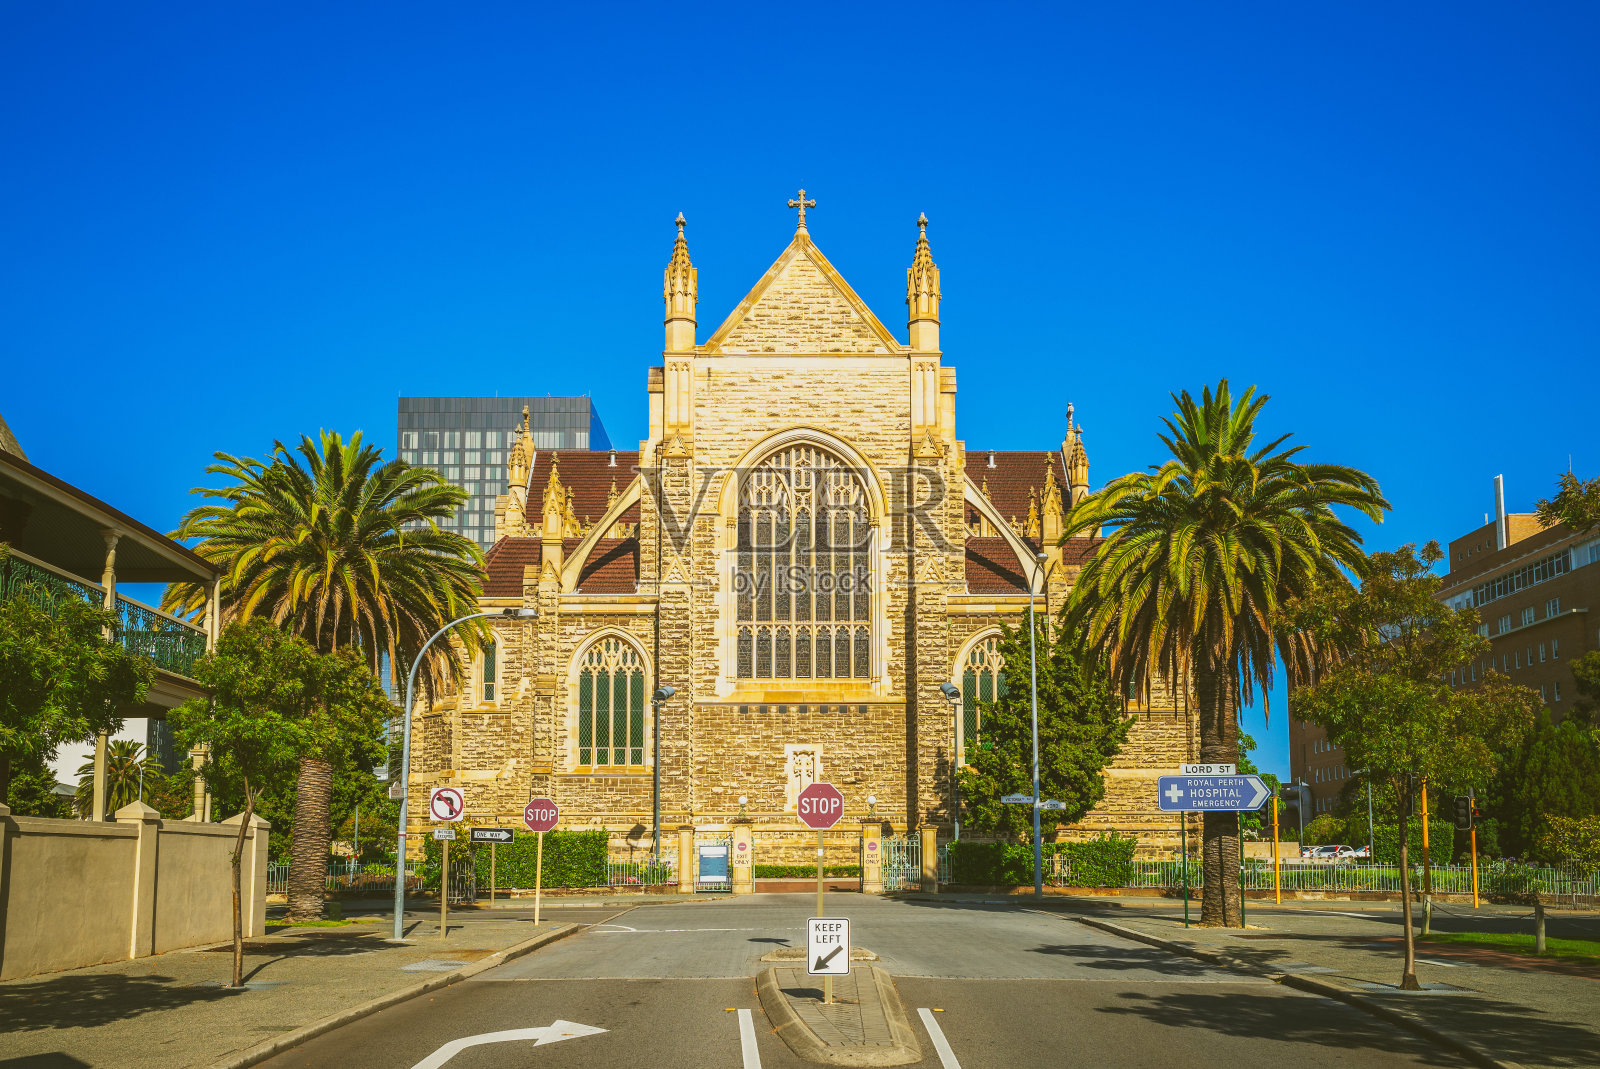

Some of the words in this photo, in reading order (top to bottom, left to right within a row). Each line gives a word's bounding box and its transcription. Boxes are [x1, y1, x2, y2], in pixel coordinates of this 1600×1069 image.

[1185, 766, 1212, 774] LORD
[1219, 765, 1231, 773] ST
[1190, 788, 1242, 798] HOSPITAL
[801, 797, 840, 815] STOP
[1192, 800, 1241, 808] EMERGENCY
[526, 808, 557, 822] STOP
[815, 923, 842, 932] KEEP
[816, 935, 841, 944] LEFT
